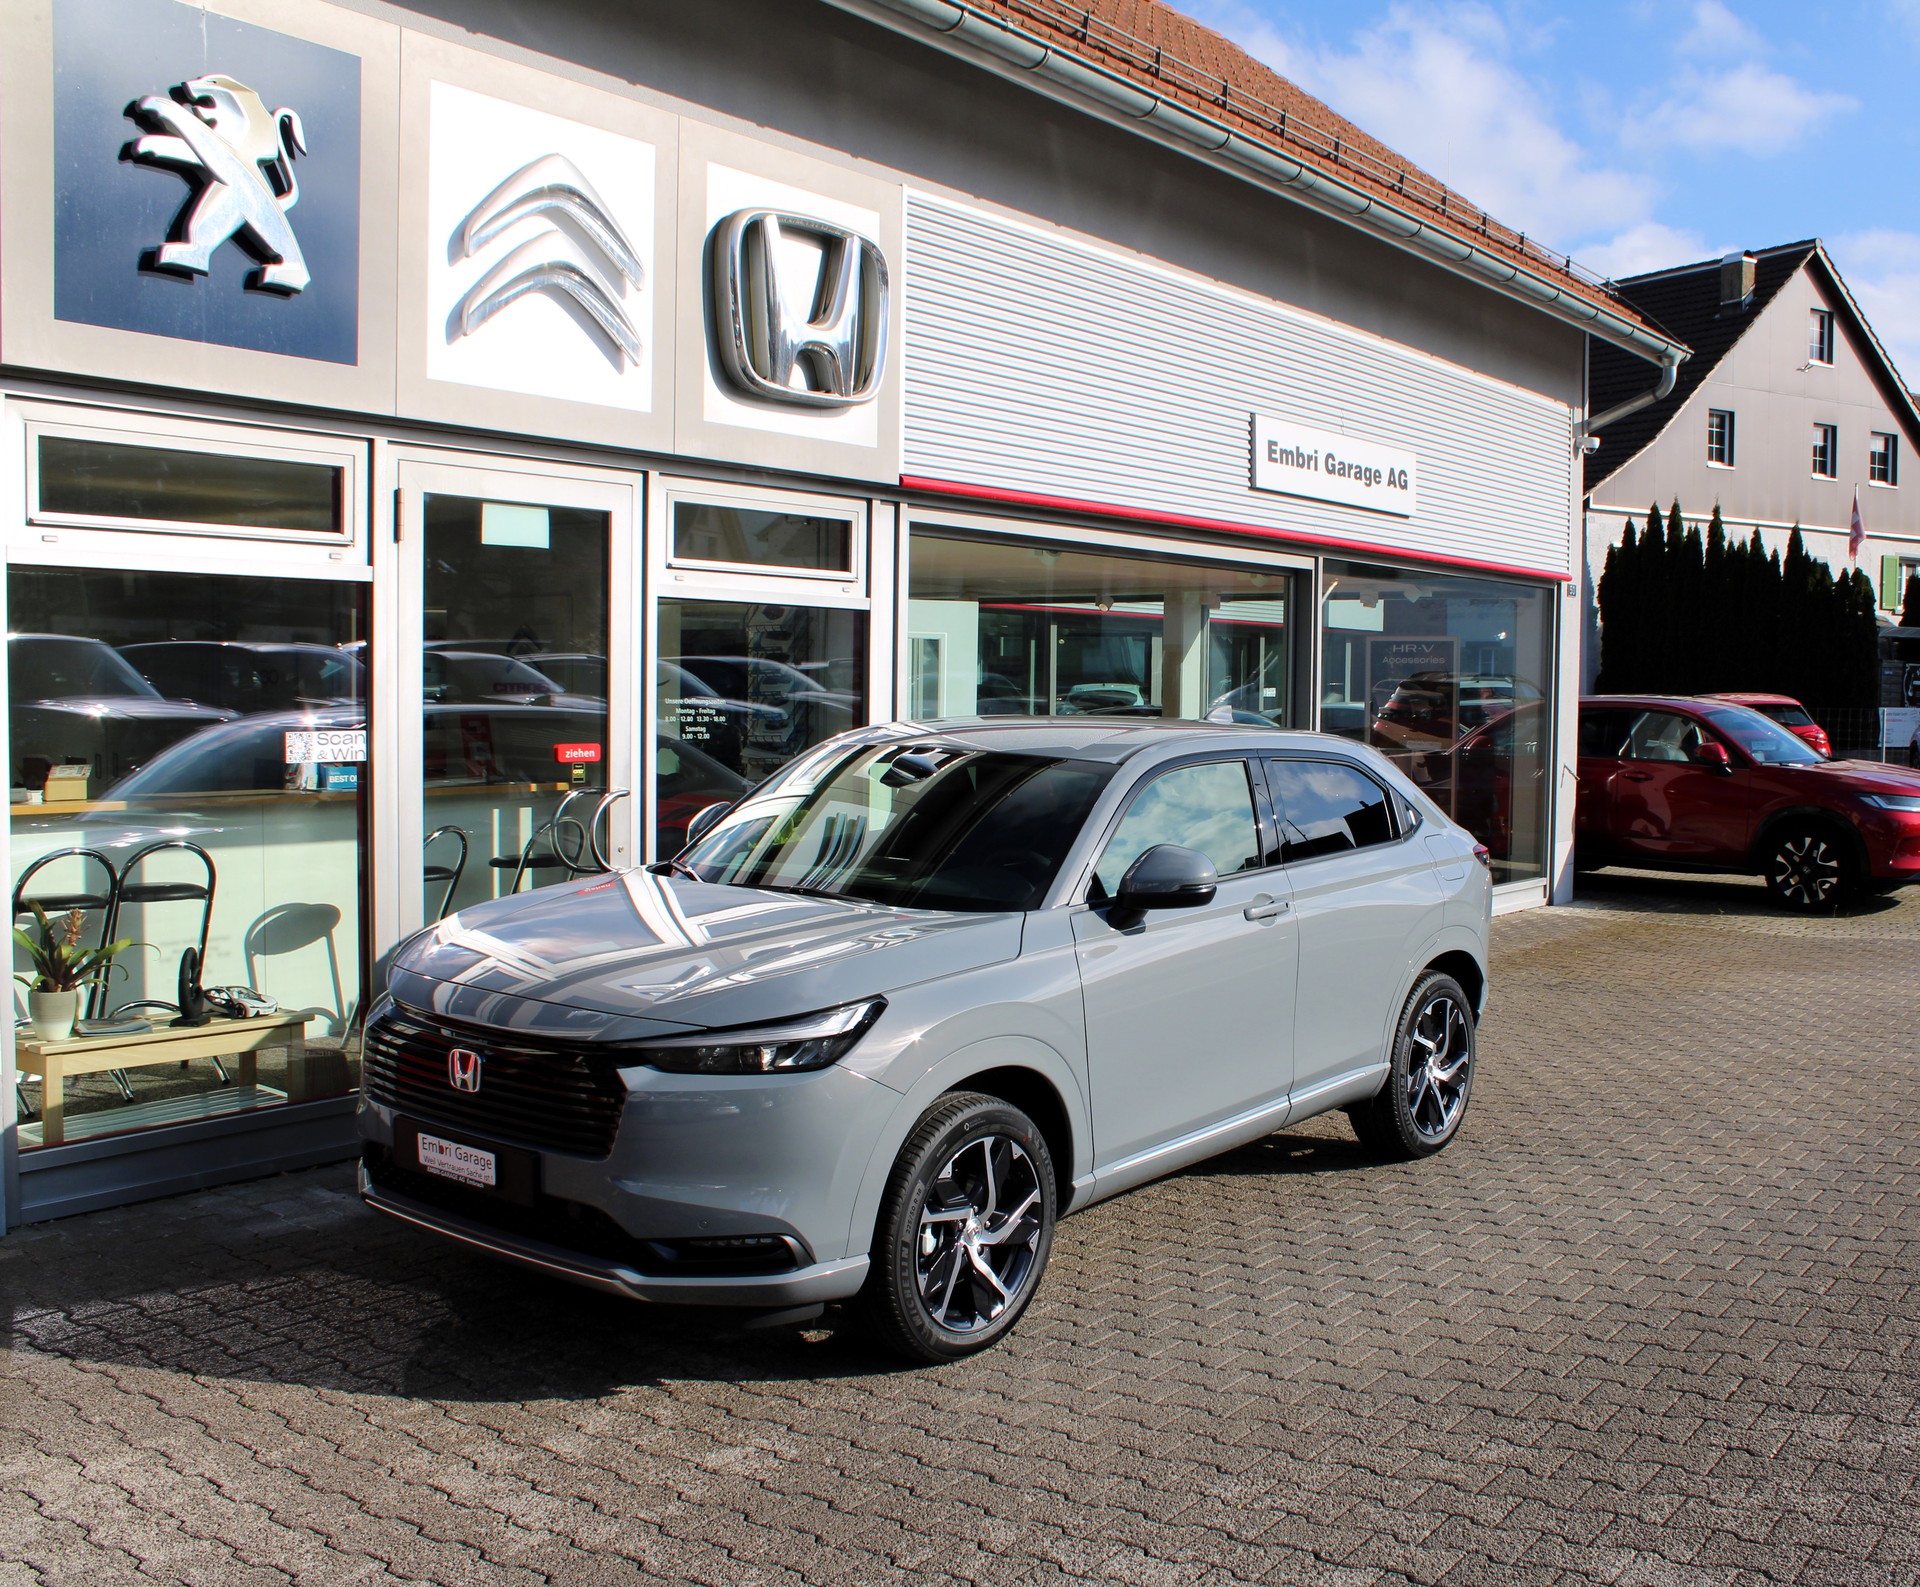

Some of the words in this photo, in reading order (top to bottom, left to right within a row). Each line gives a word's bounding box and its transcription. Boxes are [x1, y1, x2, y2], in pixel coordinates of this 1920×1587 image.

[1267, 439, 1319, 472] Embri
[1324, 452, 1382, 488] Garage
[1387, 467, 1409, 491] AG
[1382, 656, 1446, 664] Accessories
[684, 698, 726, 706] Oeffnungszeiten
[317, 732, 366, 746] Scan
[317, 750, 328, 760] &
[331, 746, 366, 761] Win
[565, 748, 595, 758] ziehen
[329, 775, 349, 783] BEST
[421, 1136, 452, 1157] Embri
[454, 1147, 493, 1171] Garage
[423, 1155, 436, 1164] Weil
[436, 1158, 466, 1174] Vertrauen
[466, 1167, 483, 1180] Sache
[901, 1246, 923, 1328] MICHELIN
